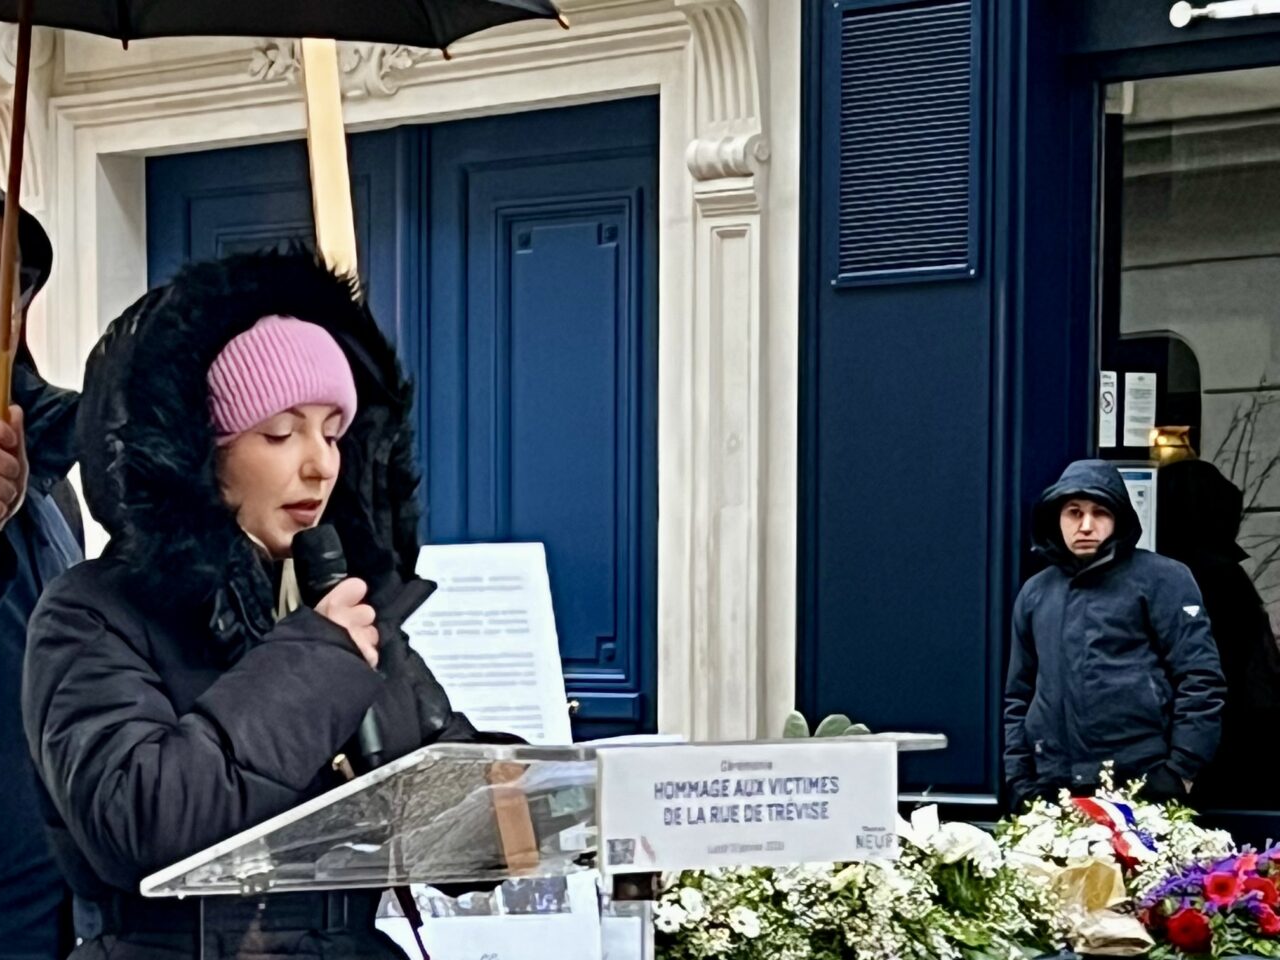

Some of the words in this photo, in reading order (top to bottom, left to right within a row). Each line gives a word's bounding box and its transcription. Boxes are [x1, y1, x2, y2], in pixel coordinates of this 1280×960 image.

[653, 779, 730, 800] HOMMAGE
[733, 778, 765, 797] AUX
[768, 776, 840, 796] VICTIMES
[663, 807, 682, 826] DE
[687, 806, 706, 825] LA
[709, 804, 740, 824] RUE
[744, 803, 763, 823] DE
